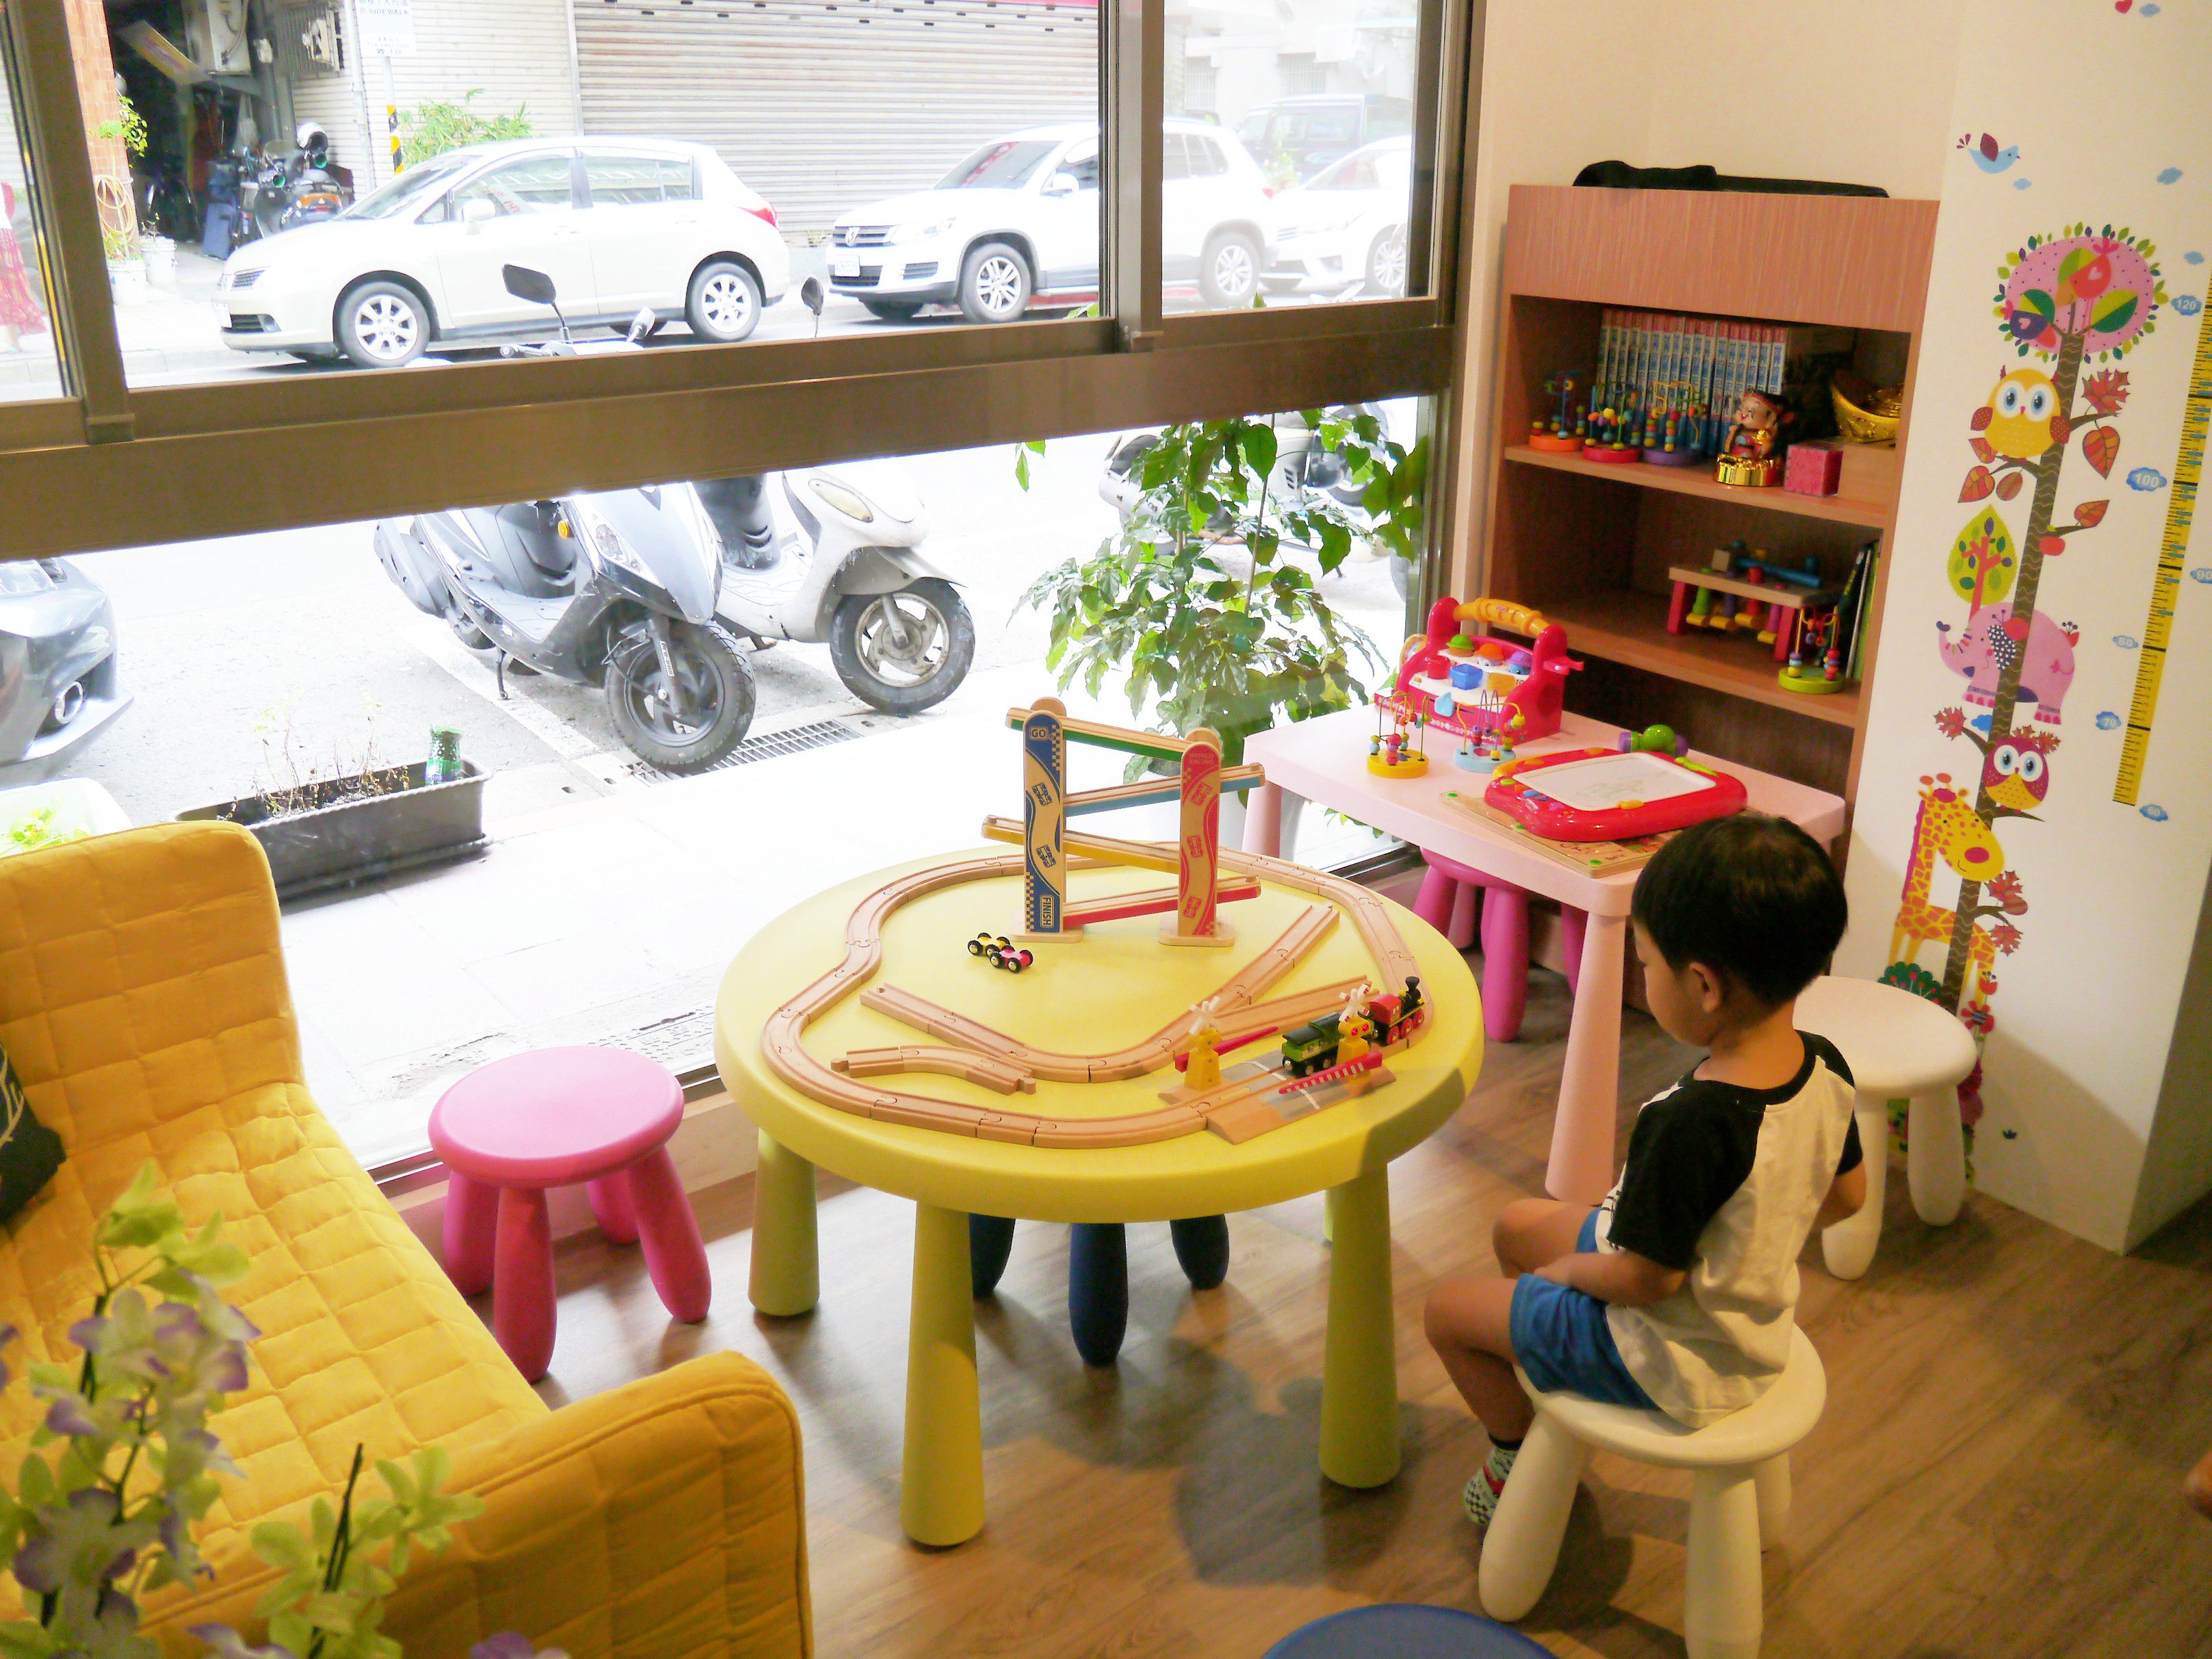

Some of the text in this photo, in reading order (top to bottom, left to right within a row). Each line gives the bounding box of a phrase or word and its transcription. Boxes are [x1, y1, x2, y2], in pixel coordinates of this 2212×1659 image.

[2178, 299, 2196, 310] 120
[2135, 474, 2159, 487] 100
[2104, 719, 2117, 728] 70
[1031, 729, 1046, 738] GO
[1042, 897, 1052, 925] FINISH
